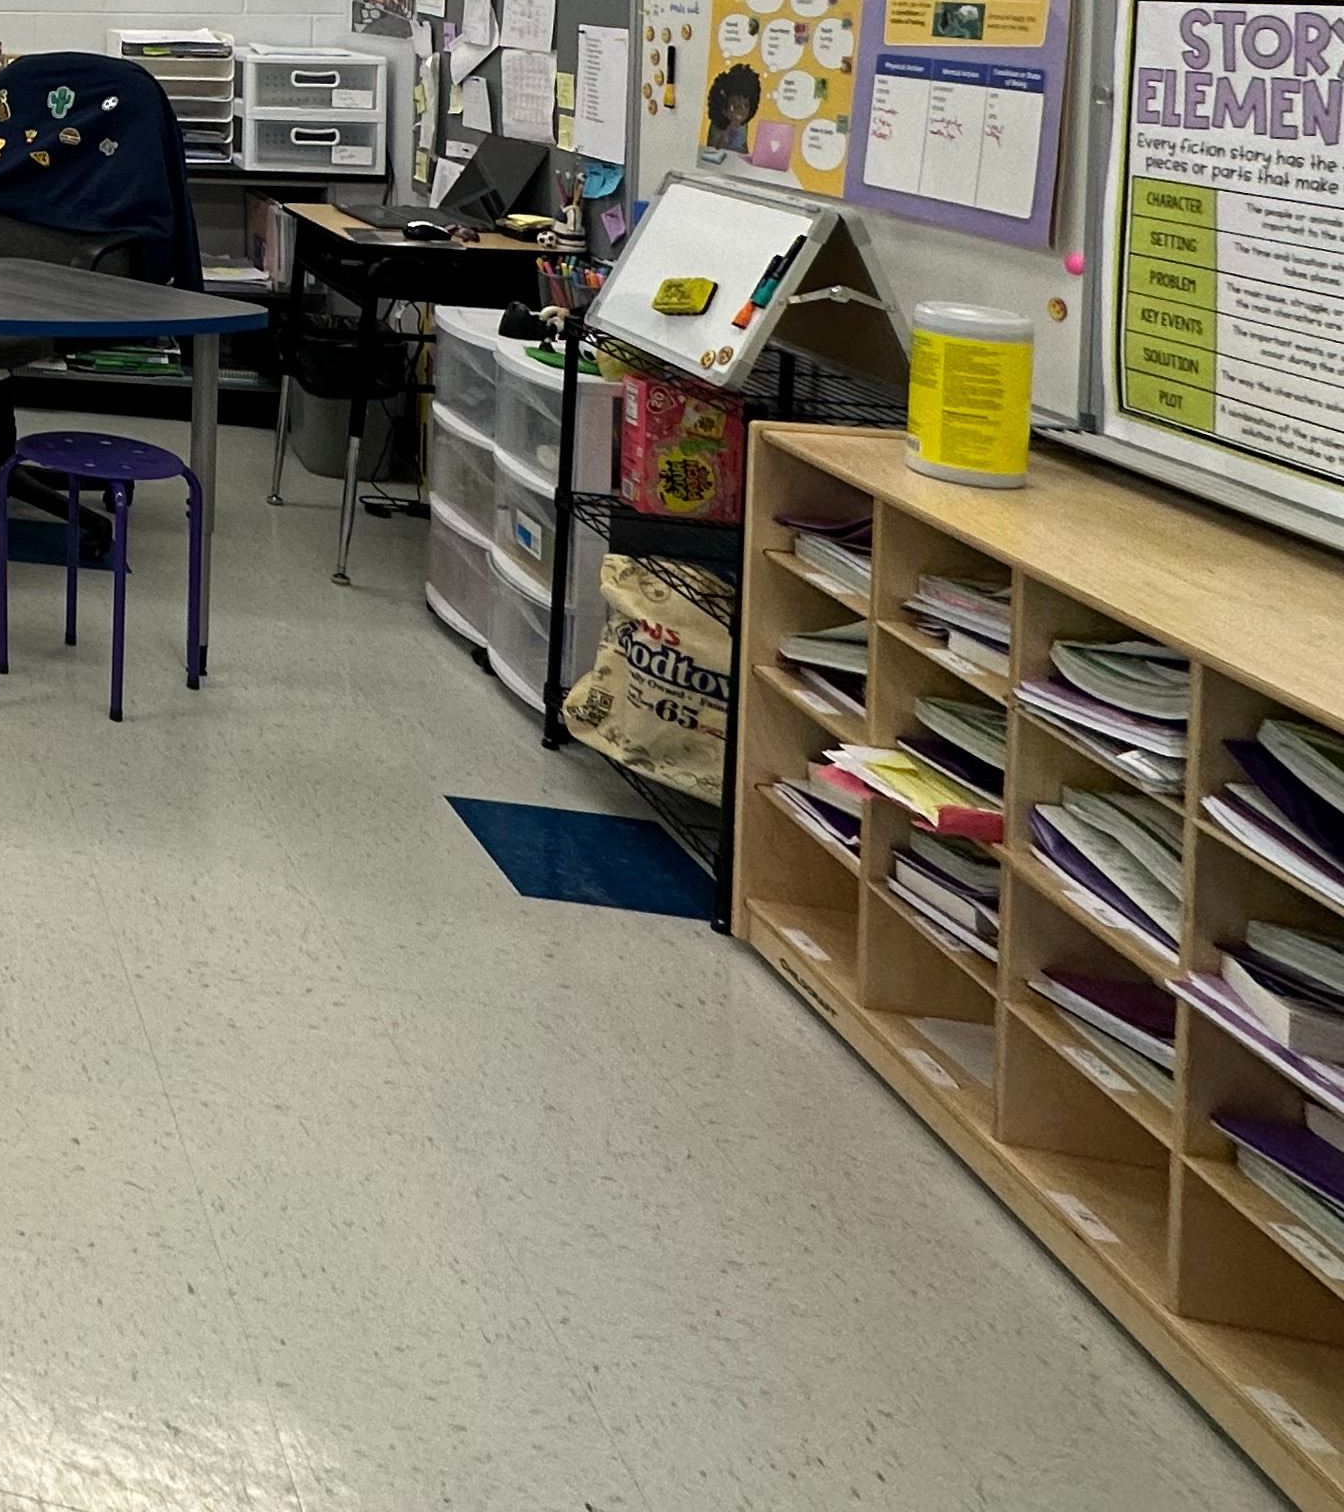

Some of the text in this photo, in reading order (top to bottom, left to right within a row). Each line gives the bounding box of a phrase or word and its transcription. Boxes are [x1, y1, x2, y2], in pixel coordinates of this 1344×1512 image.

[1137, 132, 1338, 172] Every fiction story has the
[1146, 155, 1340, 195] pieces or parts that make
[1146, 192, 1203, 214] CHARACTER
[1150, 231, 1197, 253] SETTING
[1149, 270, 1197, 293] PROBLEM
[1141, 308, 1203, 335] KEY EVENTS
[1143, 347, 1199, 374] SOLUTION
[1158, 390, 1183, 409] PLOT
[655, 699, 699, 729] 65
